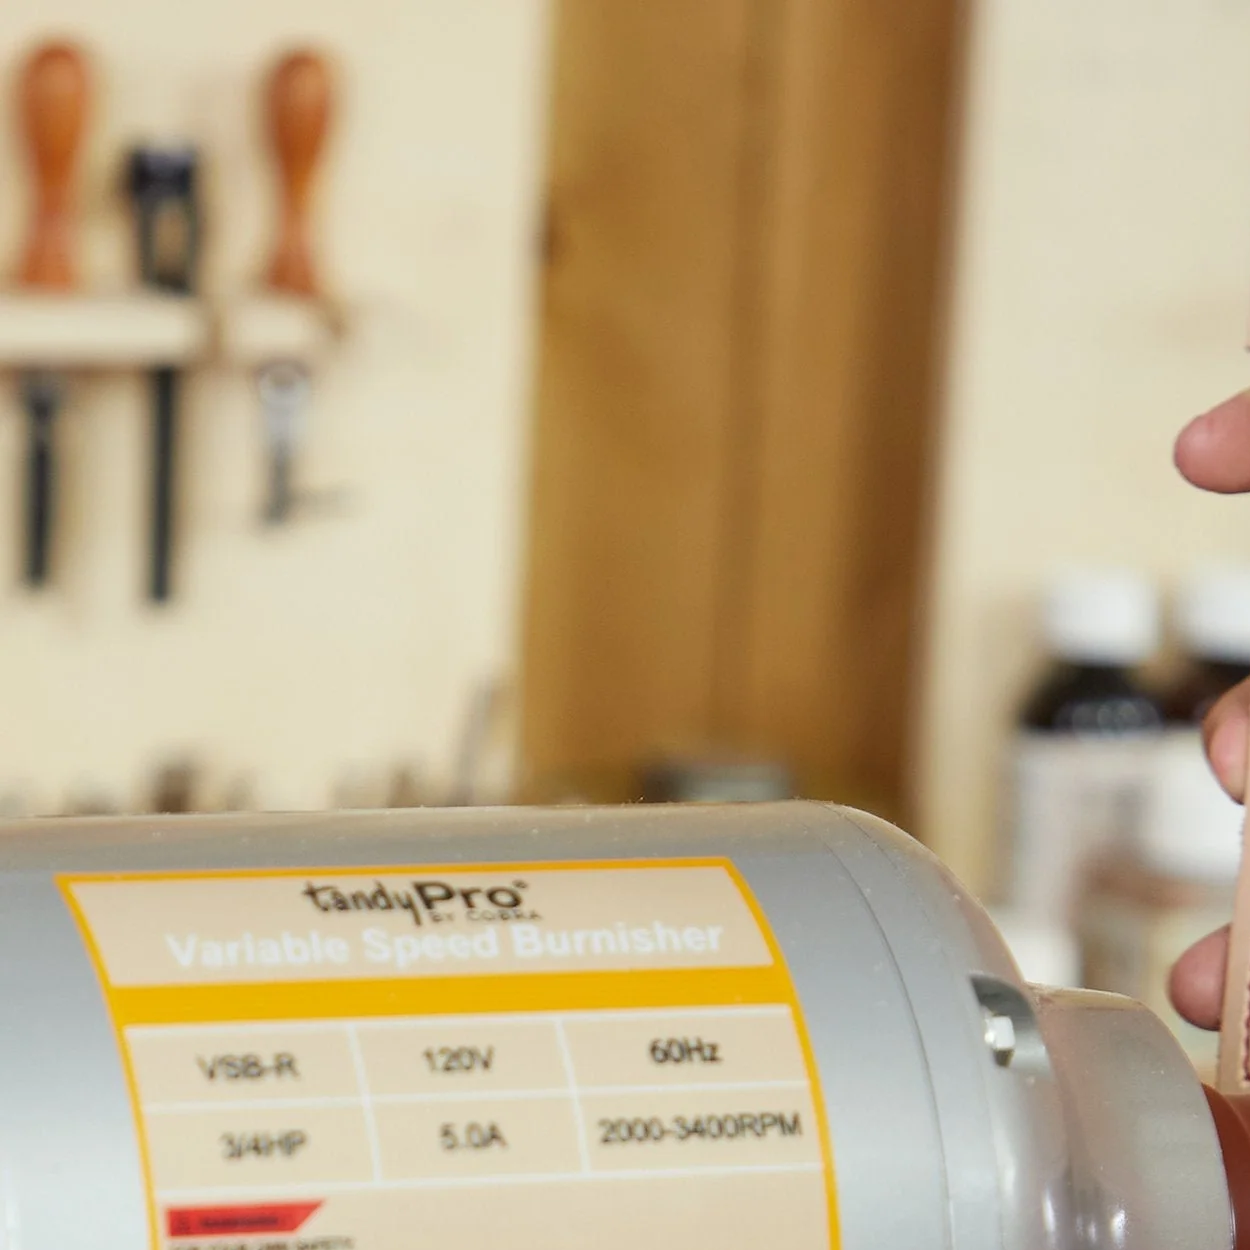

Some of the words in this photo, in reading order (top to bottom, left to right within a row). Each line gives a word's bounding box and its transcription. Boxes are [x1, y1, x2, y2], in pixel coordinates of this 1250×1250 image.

[164, 930, 349, 968] Variable
[362, 926, 499, 968] Speed
[511, 920, 723, 958] Burnisher
[422, 1046, 495, 1073] 120V
[649, 1038, 722, 1064] 60Hz
[196, 1052, 300, 1080] VSB-R
[439, 1122, 508, 1151] 5.0A
[598, 1113, 803, 1144] 2000-3400RPM
[220, 1130, 307, 1160] 3/4HP
